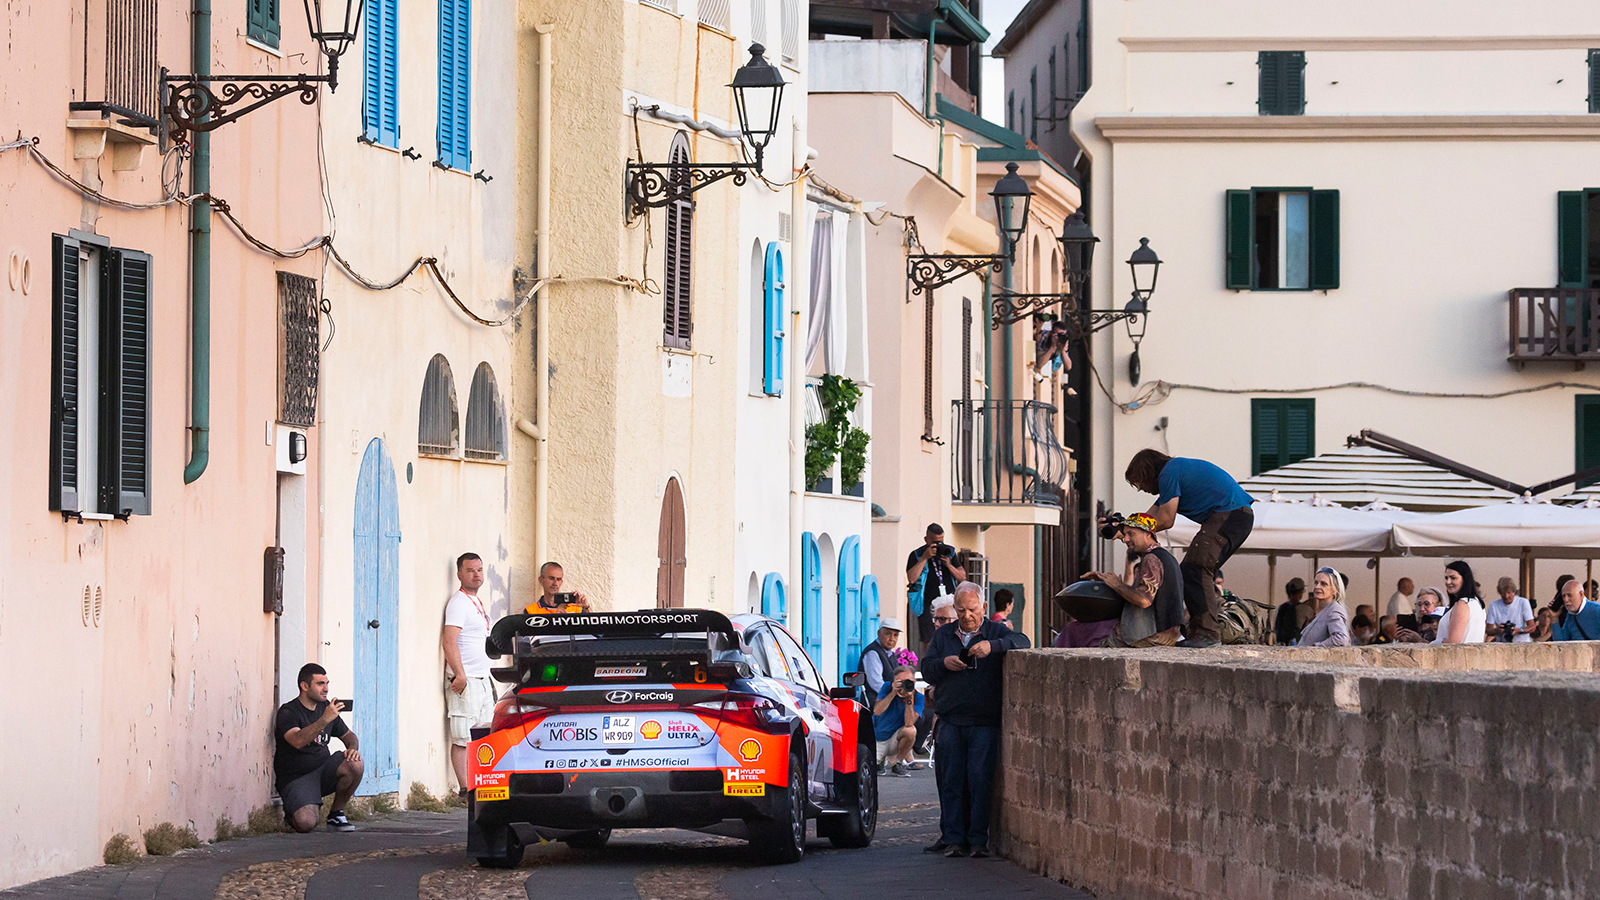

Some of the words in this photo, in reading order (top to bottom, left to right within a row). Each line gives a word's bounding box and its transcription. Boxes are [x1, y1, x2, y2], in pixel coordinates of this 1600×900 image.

[552, 616, 613, 626] HYUNDAI
[615, 614, 699, 625] MOTORSPORT
[635, 691, 674, 701] ForCraig
[613, 718, 630, 727] ALZ
[549, 727, 598, 742] MOBIS
[605, 731, 616, 741] WR
[617, 731, 633, 741] 909
[615, 758, 690, 767] #HMSGOfficial
[477, 789, 506, 799] PIRELLI
[727, 785, 763, 794] PIRELLI
